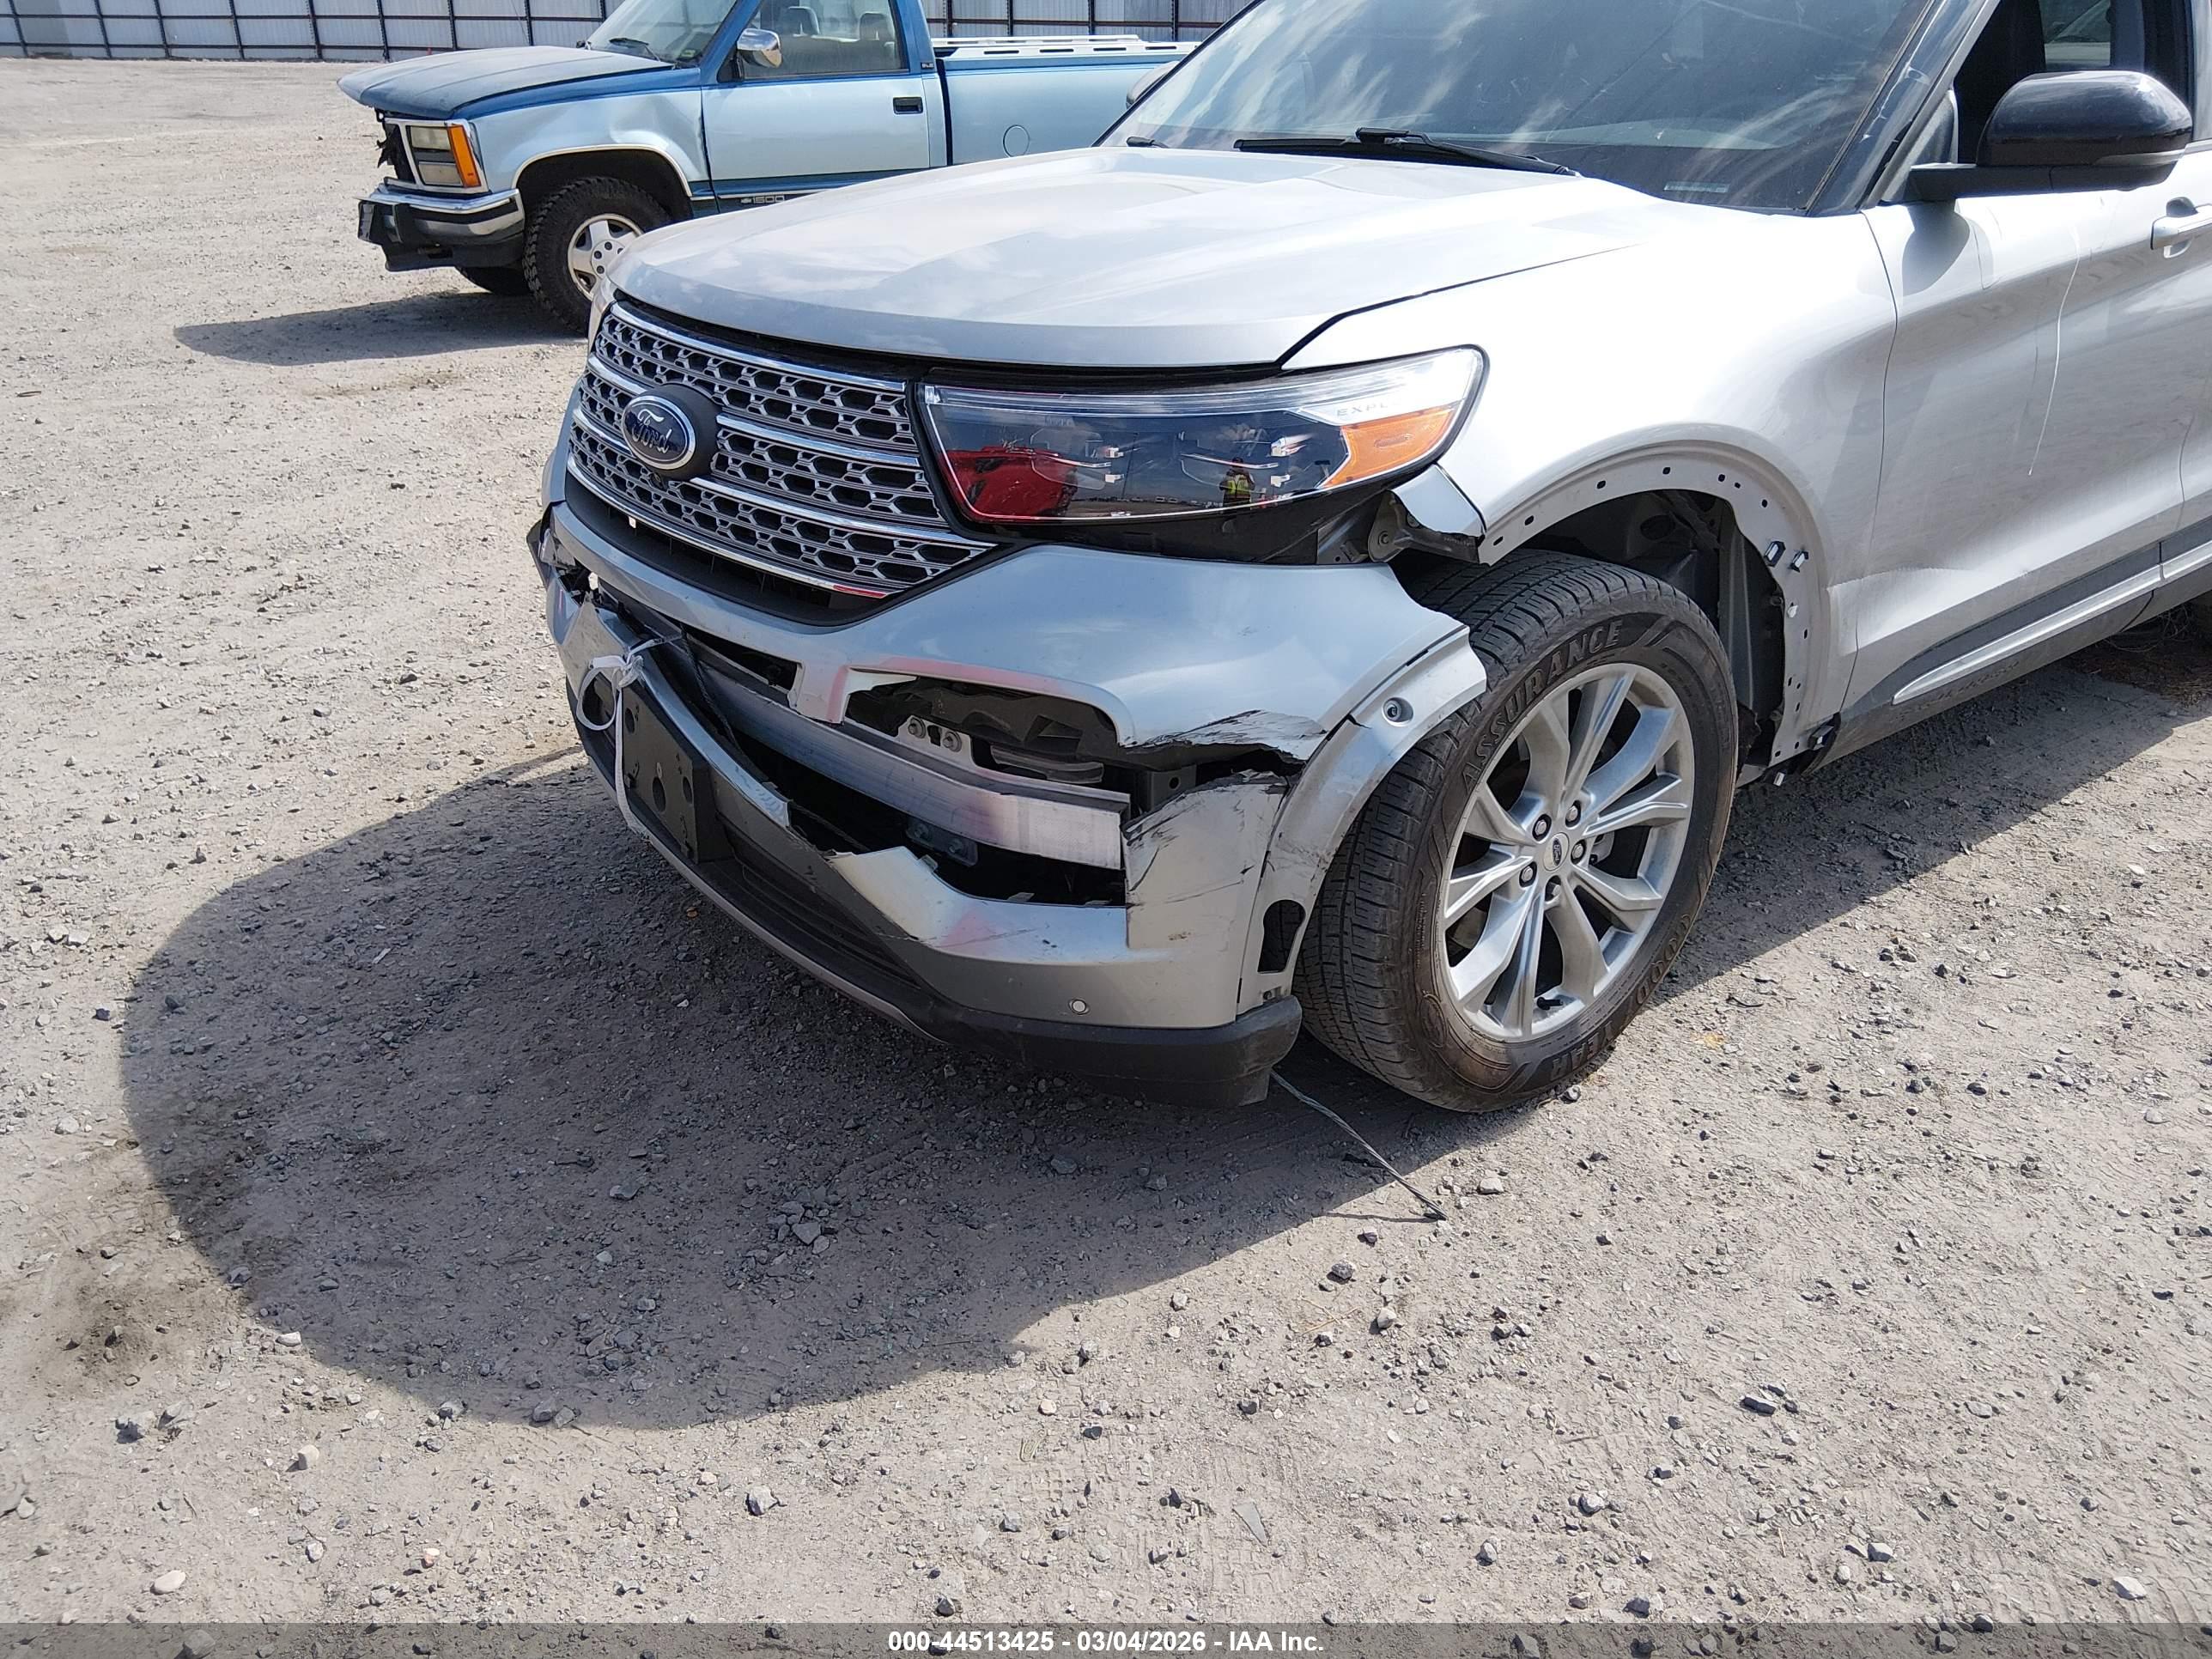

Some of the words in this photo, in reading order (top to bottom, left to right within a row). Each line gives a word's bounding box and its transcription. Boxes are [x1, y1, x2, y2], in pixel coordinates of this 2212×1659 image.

[753, 195, 785, 204] 1500
[1336, 401, 1398, 417] EXPL
[631, 408, 672, 454] Ford
[1462, 618, 1624, 795] ASSURANCE
